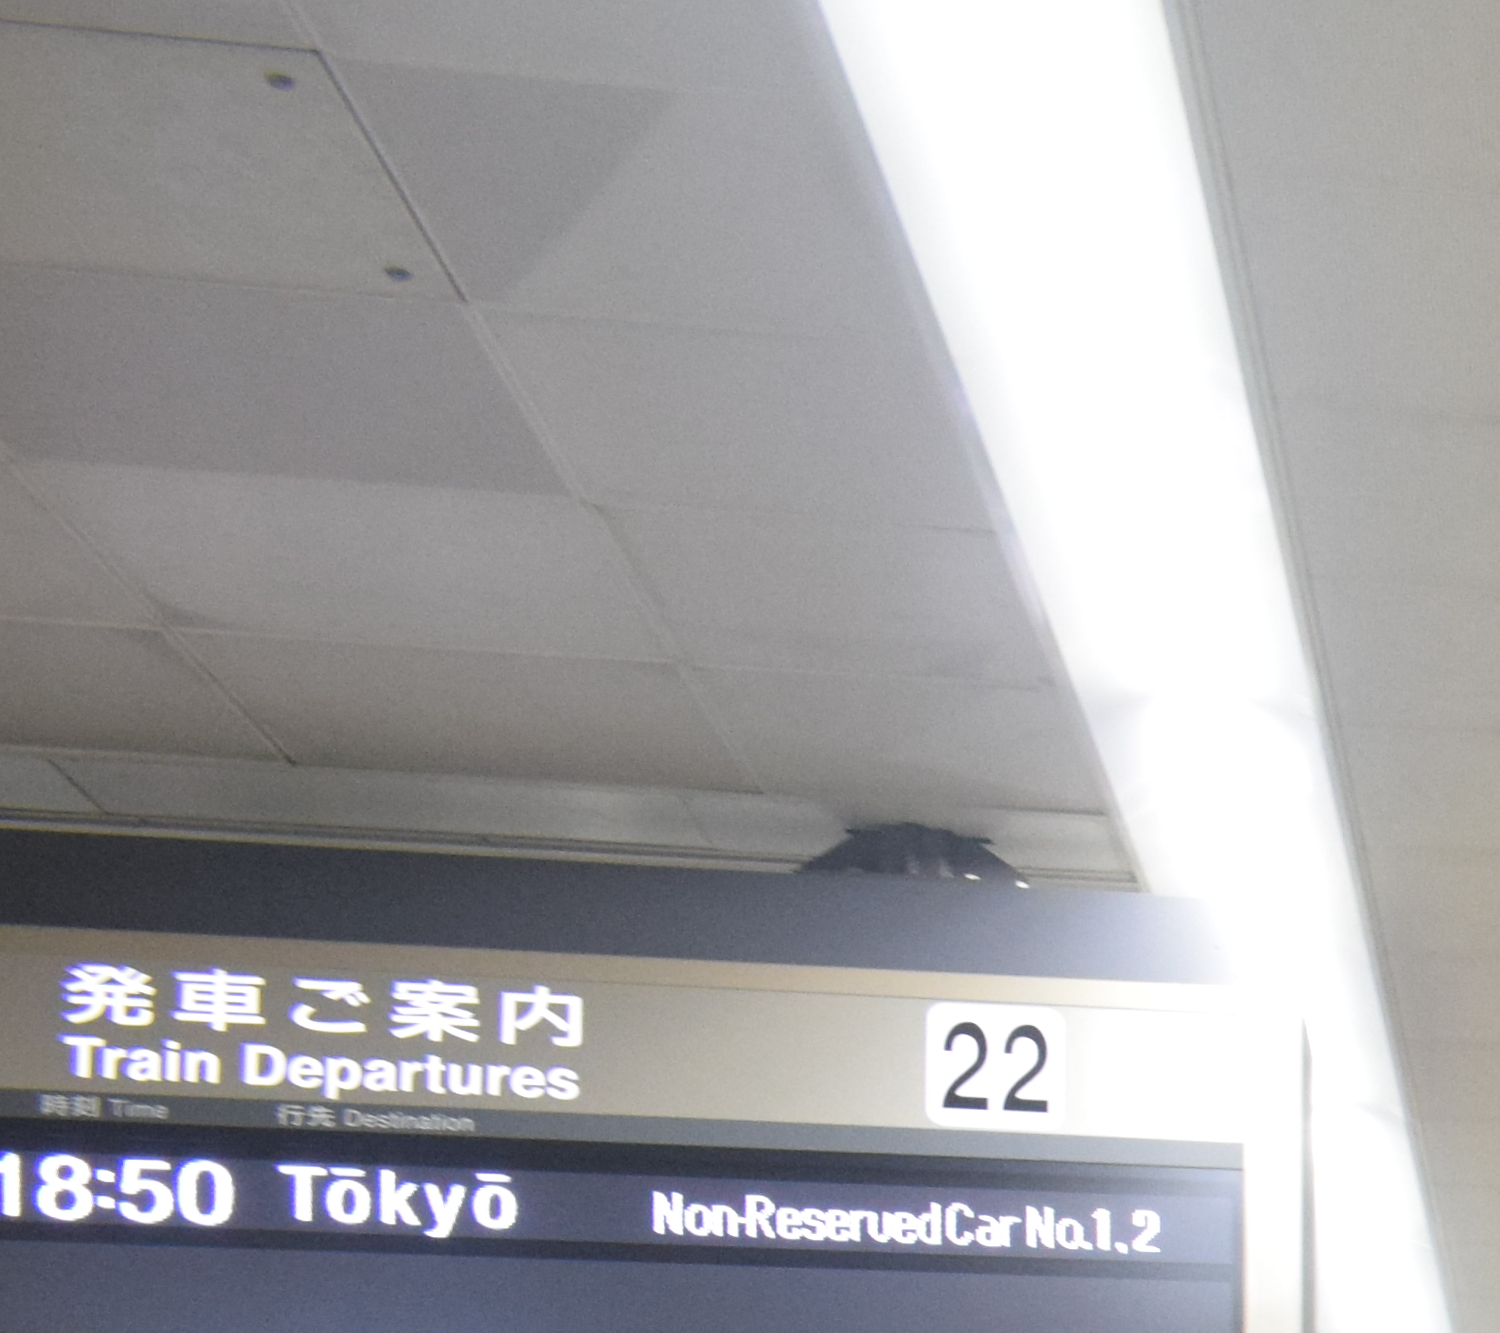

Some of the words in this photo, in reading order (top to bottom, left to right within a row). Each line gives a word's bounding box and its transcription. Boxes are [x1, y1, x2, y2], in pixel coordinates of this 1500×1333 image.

[61, 963, 585, 1049] 発車ご案内
[62, 1035, 221, 1086] Train
[241, 1043, 581, 1101] Departures
[942, 1021, 1048, 1113] 22
[107, 1097, 169, 1120] Time
[276, 1104, 336, 1128] 行先
[343, 1108, 476, 1132] Destination
[0, 1151, 236, 1227] 18:50
[276, 1163, 520, 1240] Tōkyō
[944, 1202, 1023, 1247] Car
